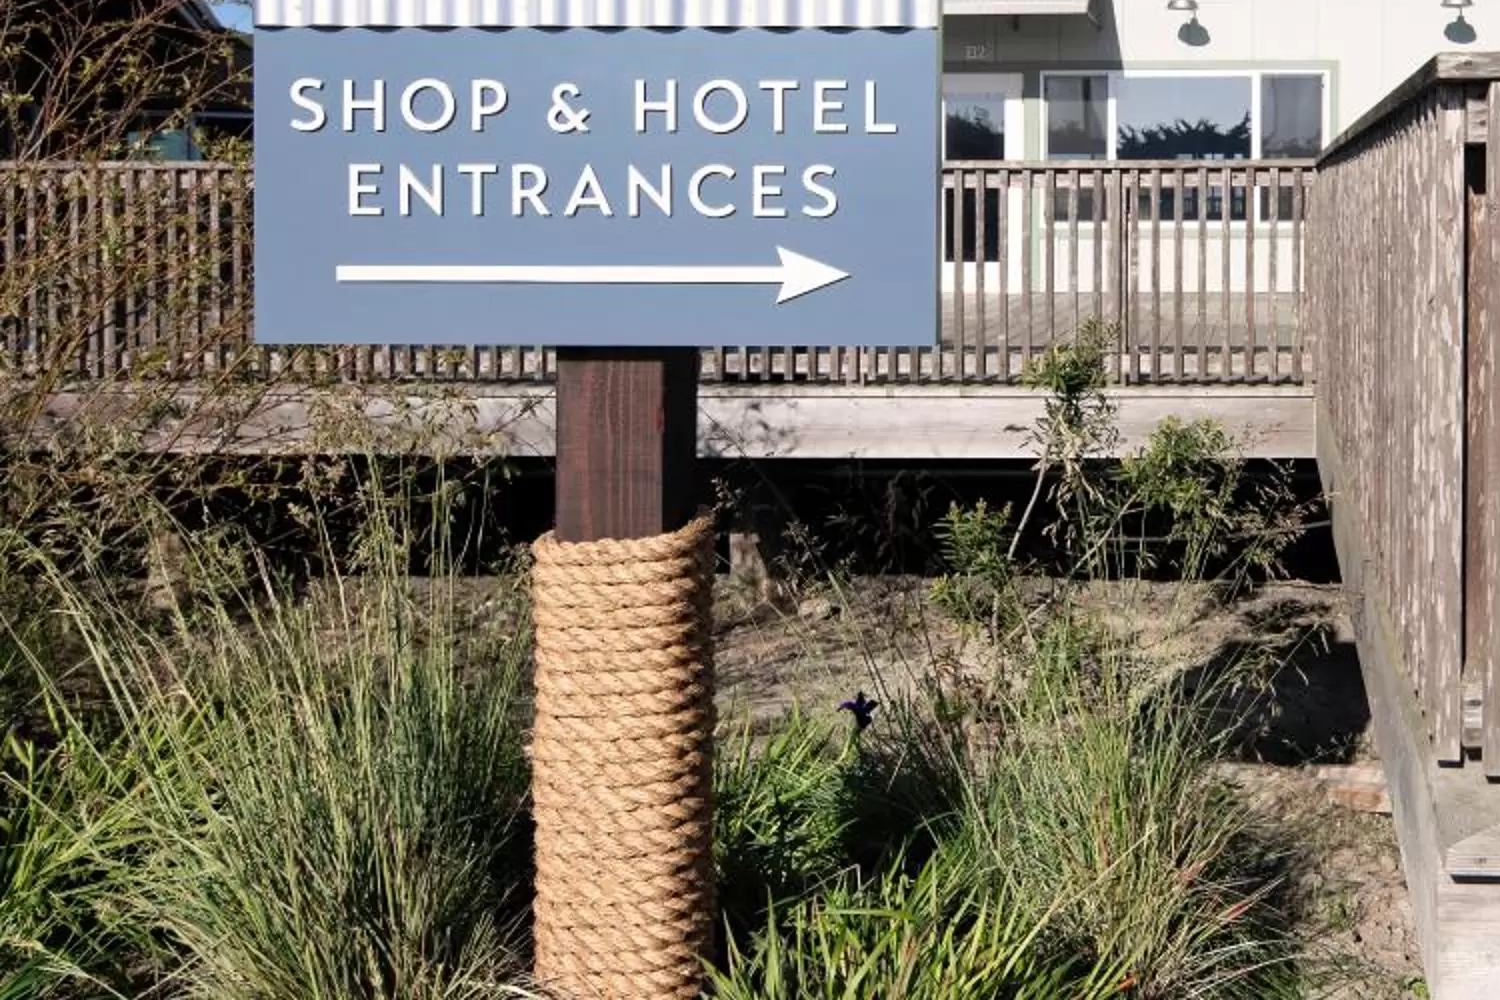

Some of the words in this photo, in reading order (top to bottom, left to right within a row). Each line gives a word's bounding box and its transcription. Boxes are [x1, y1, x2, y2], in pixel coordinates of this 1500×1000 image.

[289, 78, 508, 133] SHOP
[547, 82, 592, 134] &
[634, 79, 899, 133] HOTEL
[347, 164, 840, 218] ENTRANCES
